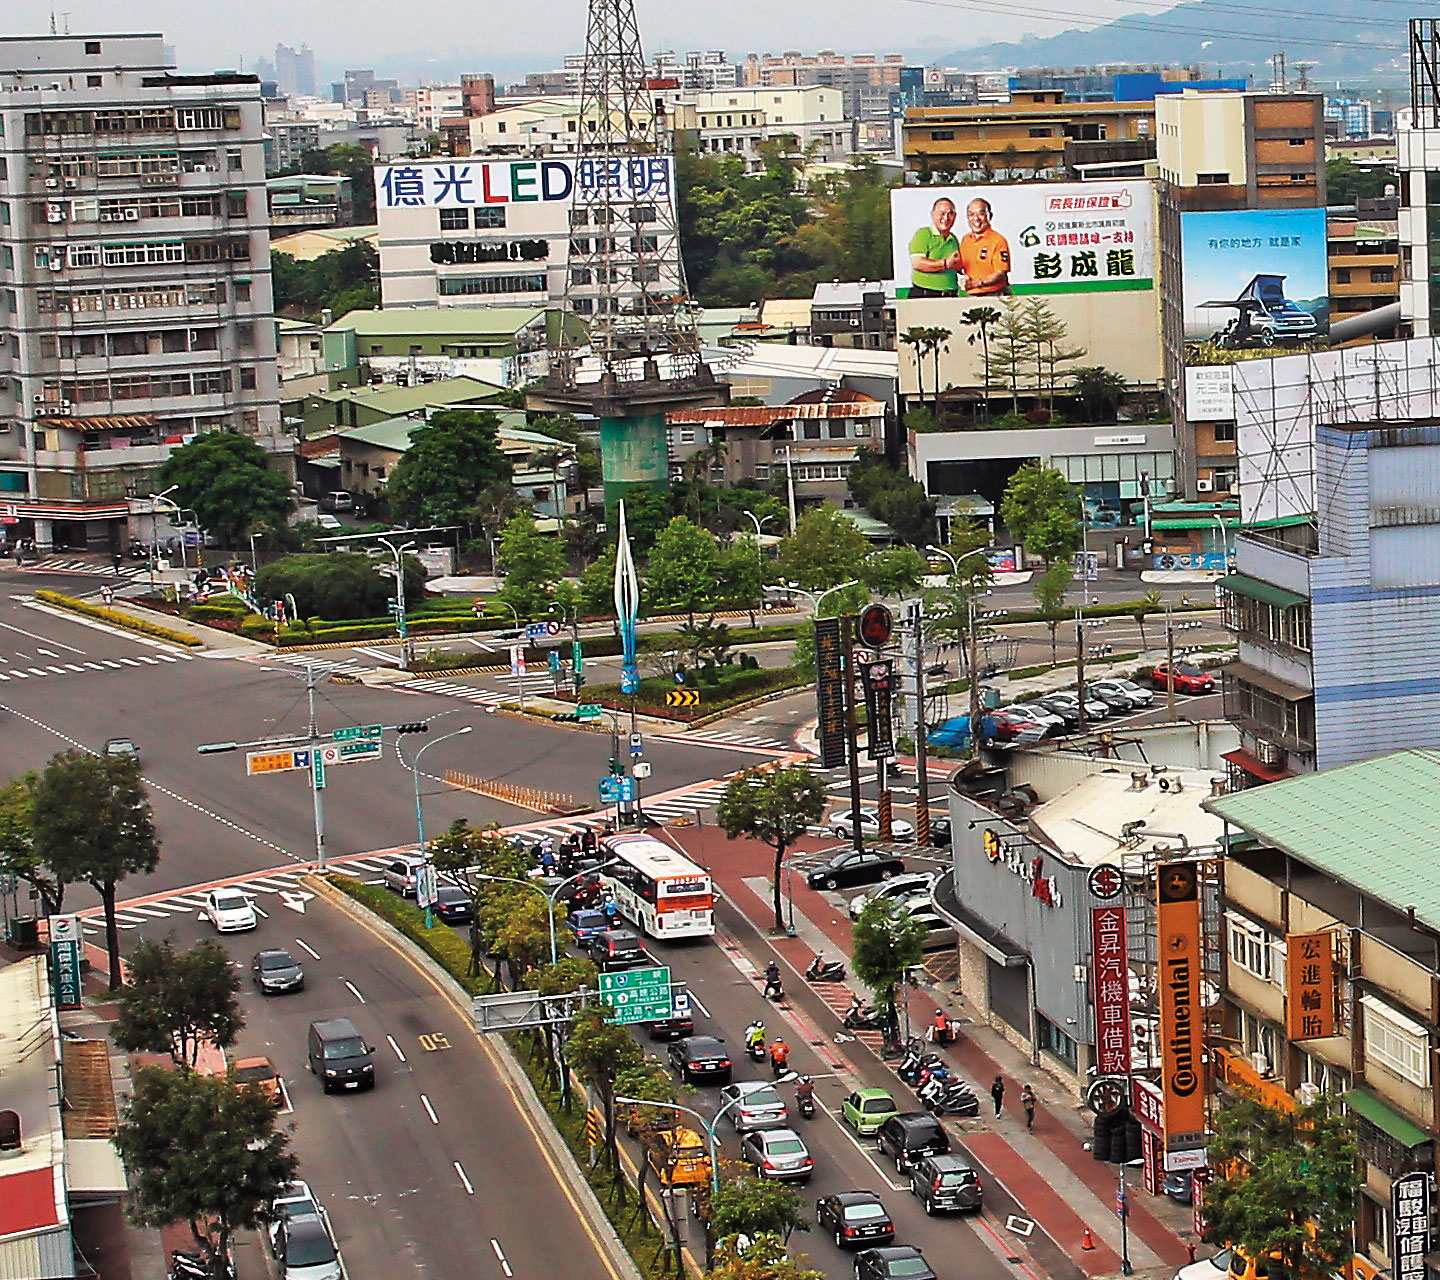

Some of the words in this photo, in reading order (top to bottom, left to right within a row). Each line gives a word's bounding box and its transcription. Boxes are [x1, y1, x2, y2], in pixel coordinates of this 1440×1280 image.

[381, 158, 670, 206] 億光LED照明
[1034, 249, 1135, 279] 彭成龍
[1208, 238, 1262, 249] 有你的地方
[1268, 237, 1302, 248] 就是家
[1098, 910, 1126, 1072] 金昇汽機車借款
[1301, 939, 1322, 1036] 宏進輪胎
[1167, 957, 1198, 1097] Continental
